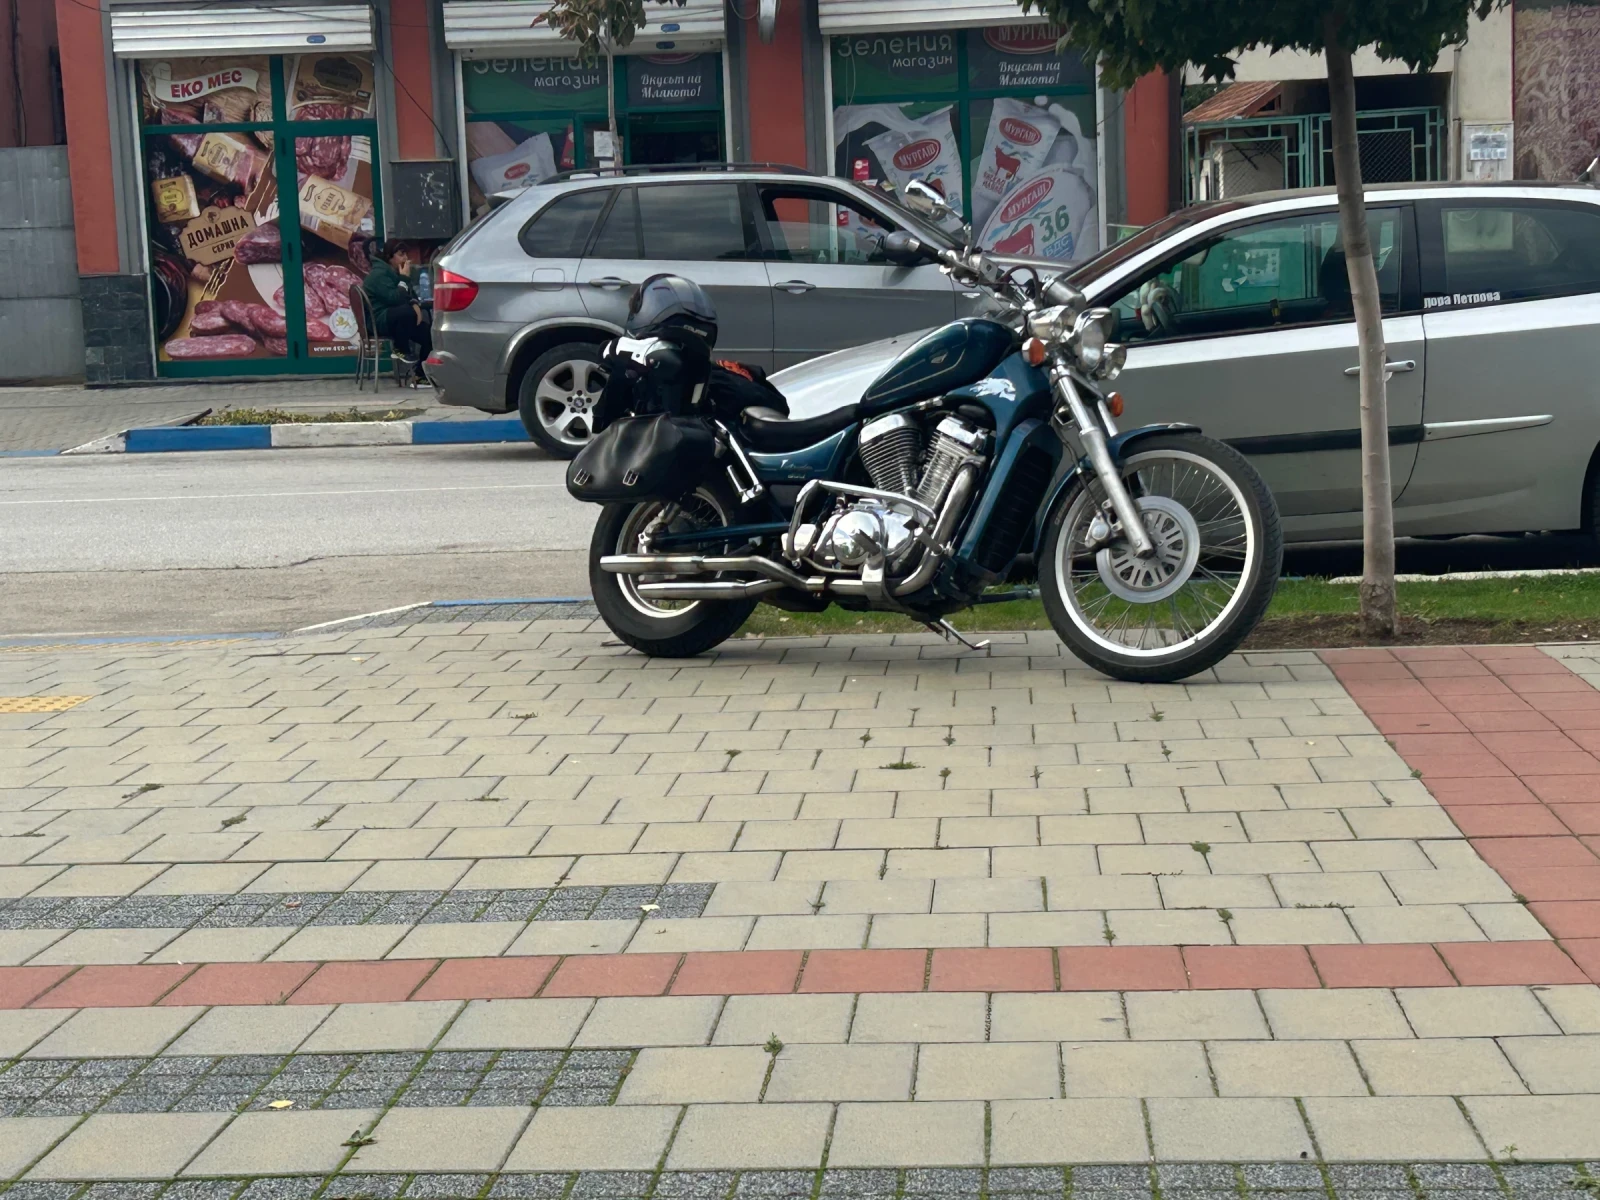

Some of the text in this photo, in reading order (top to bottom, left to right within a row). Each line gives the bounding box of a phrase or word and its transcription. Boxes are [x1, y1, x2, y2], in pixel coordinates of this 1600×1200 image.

[838, 34, 952, 57] Зеления
[892, 55, 953, 69] магазин
[998, 61, 1061, 75] Вкусът на
[170, 70, 243, 98] ЕКО МЕС
[534, 74, 600, 89] магазин
[641, 73, 702, 88] Вкусът на
[999, 72, 1060, 86] Млякото!
[1003, 121, 1037, 141] МУРГАШ
[898, 143, 937, 166] МУРГАШ
[1007, 182, 1048, 217] МУРГАШ
[187, 215, 249, 248] ДОМАШНА
[1039, 204, 1070, 243] 3,6
[1453, 291, 1501, 305] Петрова
